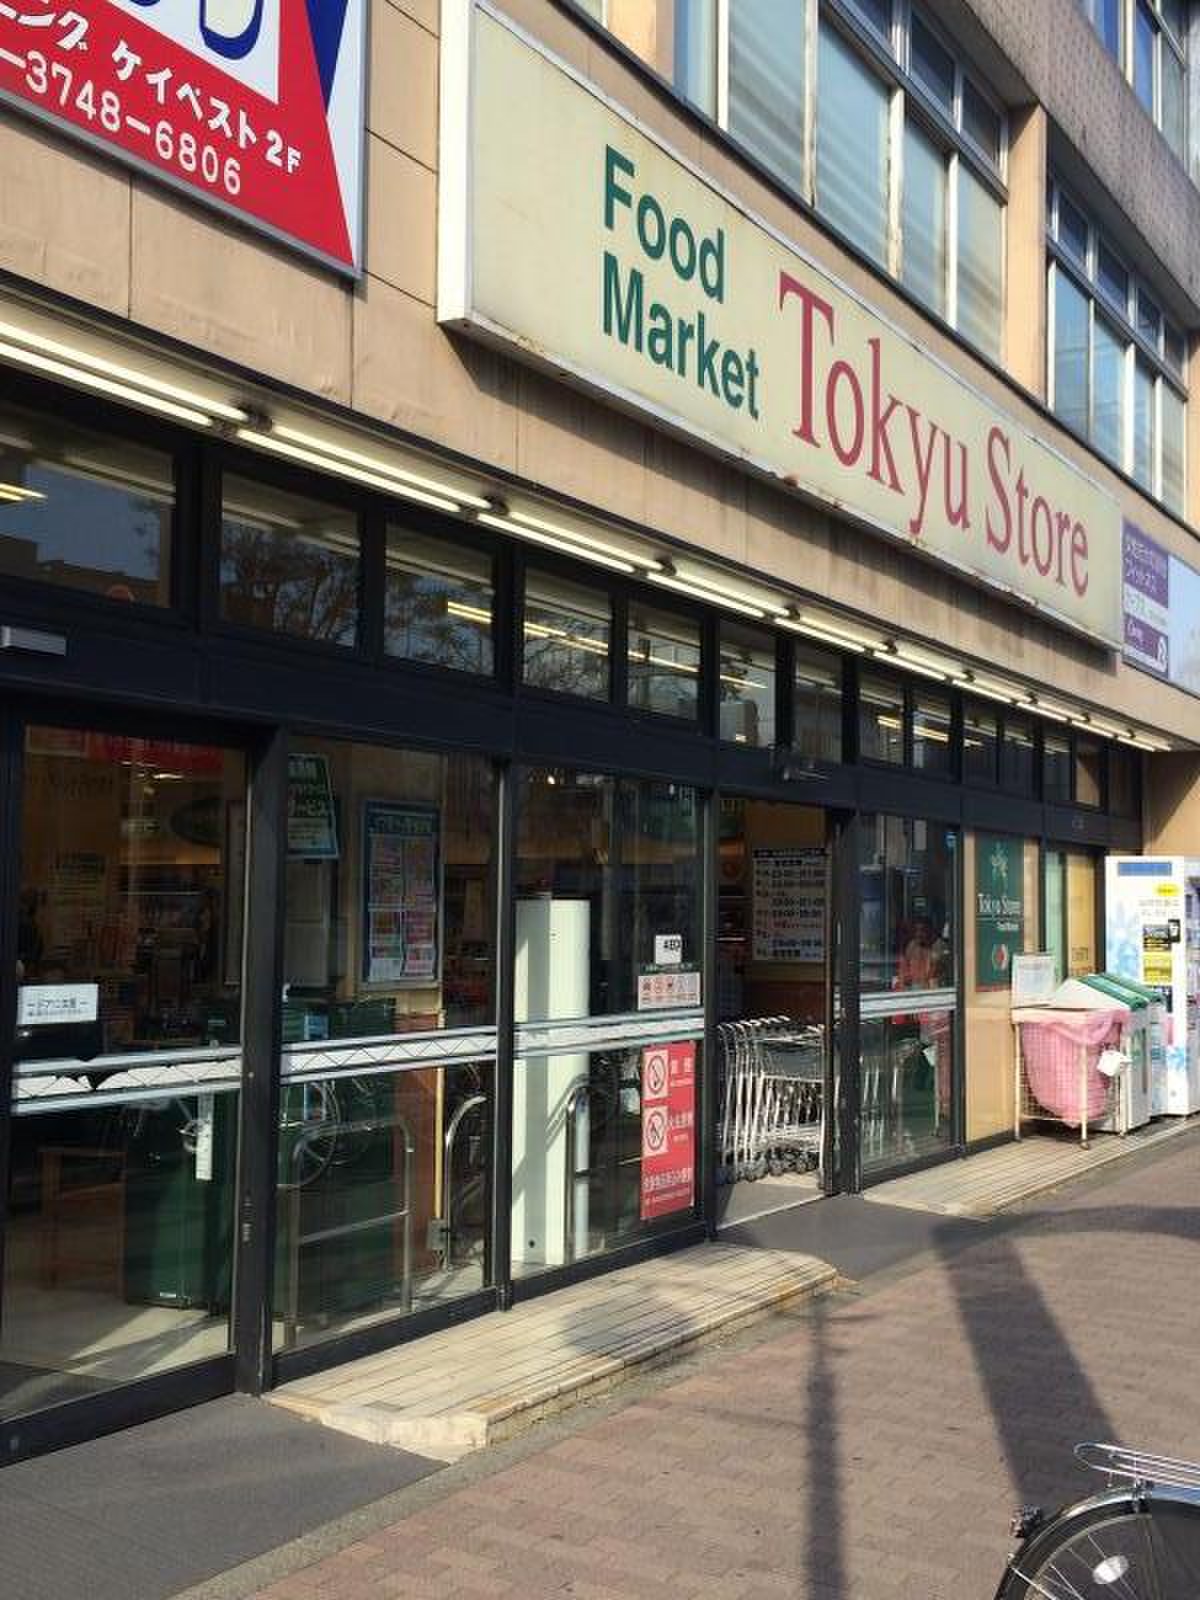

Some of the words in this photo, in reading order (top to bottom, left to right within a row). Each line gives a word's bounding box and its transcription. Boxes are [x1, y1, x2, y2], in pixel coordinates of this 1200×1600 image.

[111, 40, 257, 148] ケイベスト
[265, 130, 301, 174] 2F
[604, 143, 724, 304] Food
[603, 250, 759, 420] Market
[780, 270, 970, 535] Tokyu
[985, 426, 1089, 597] Store
